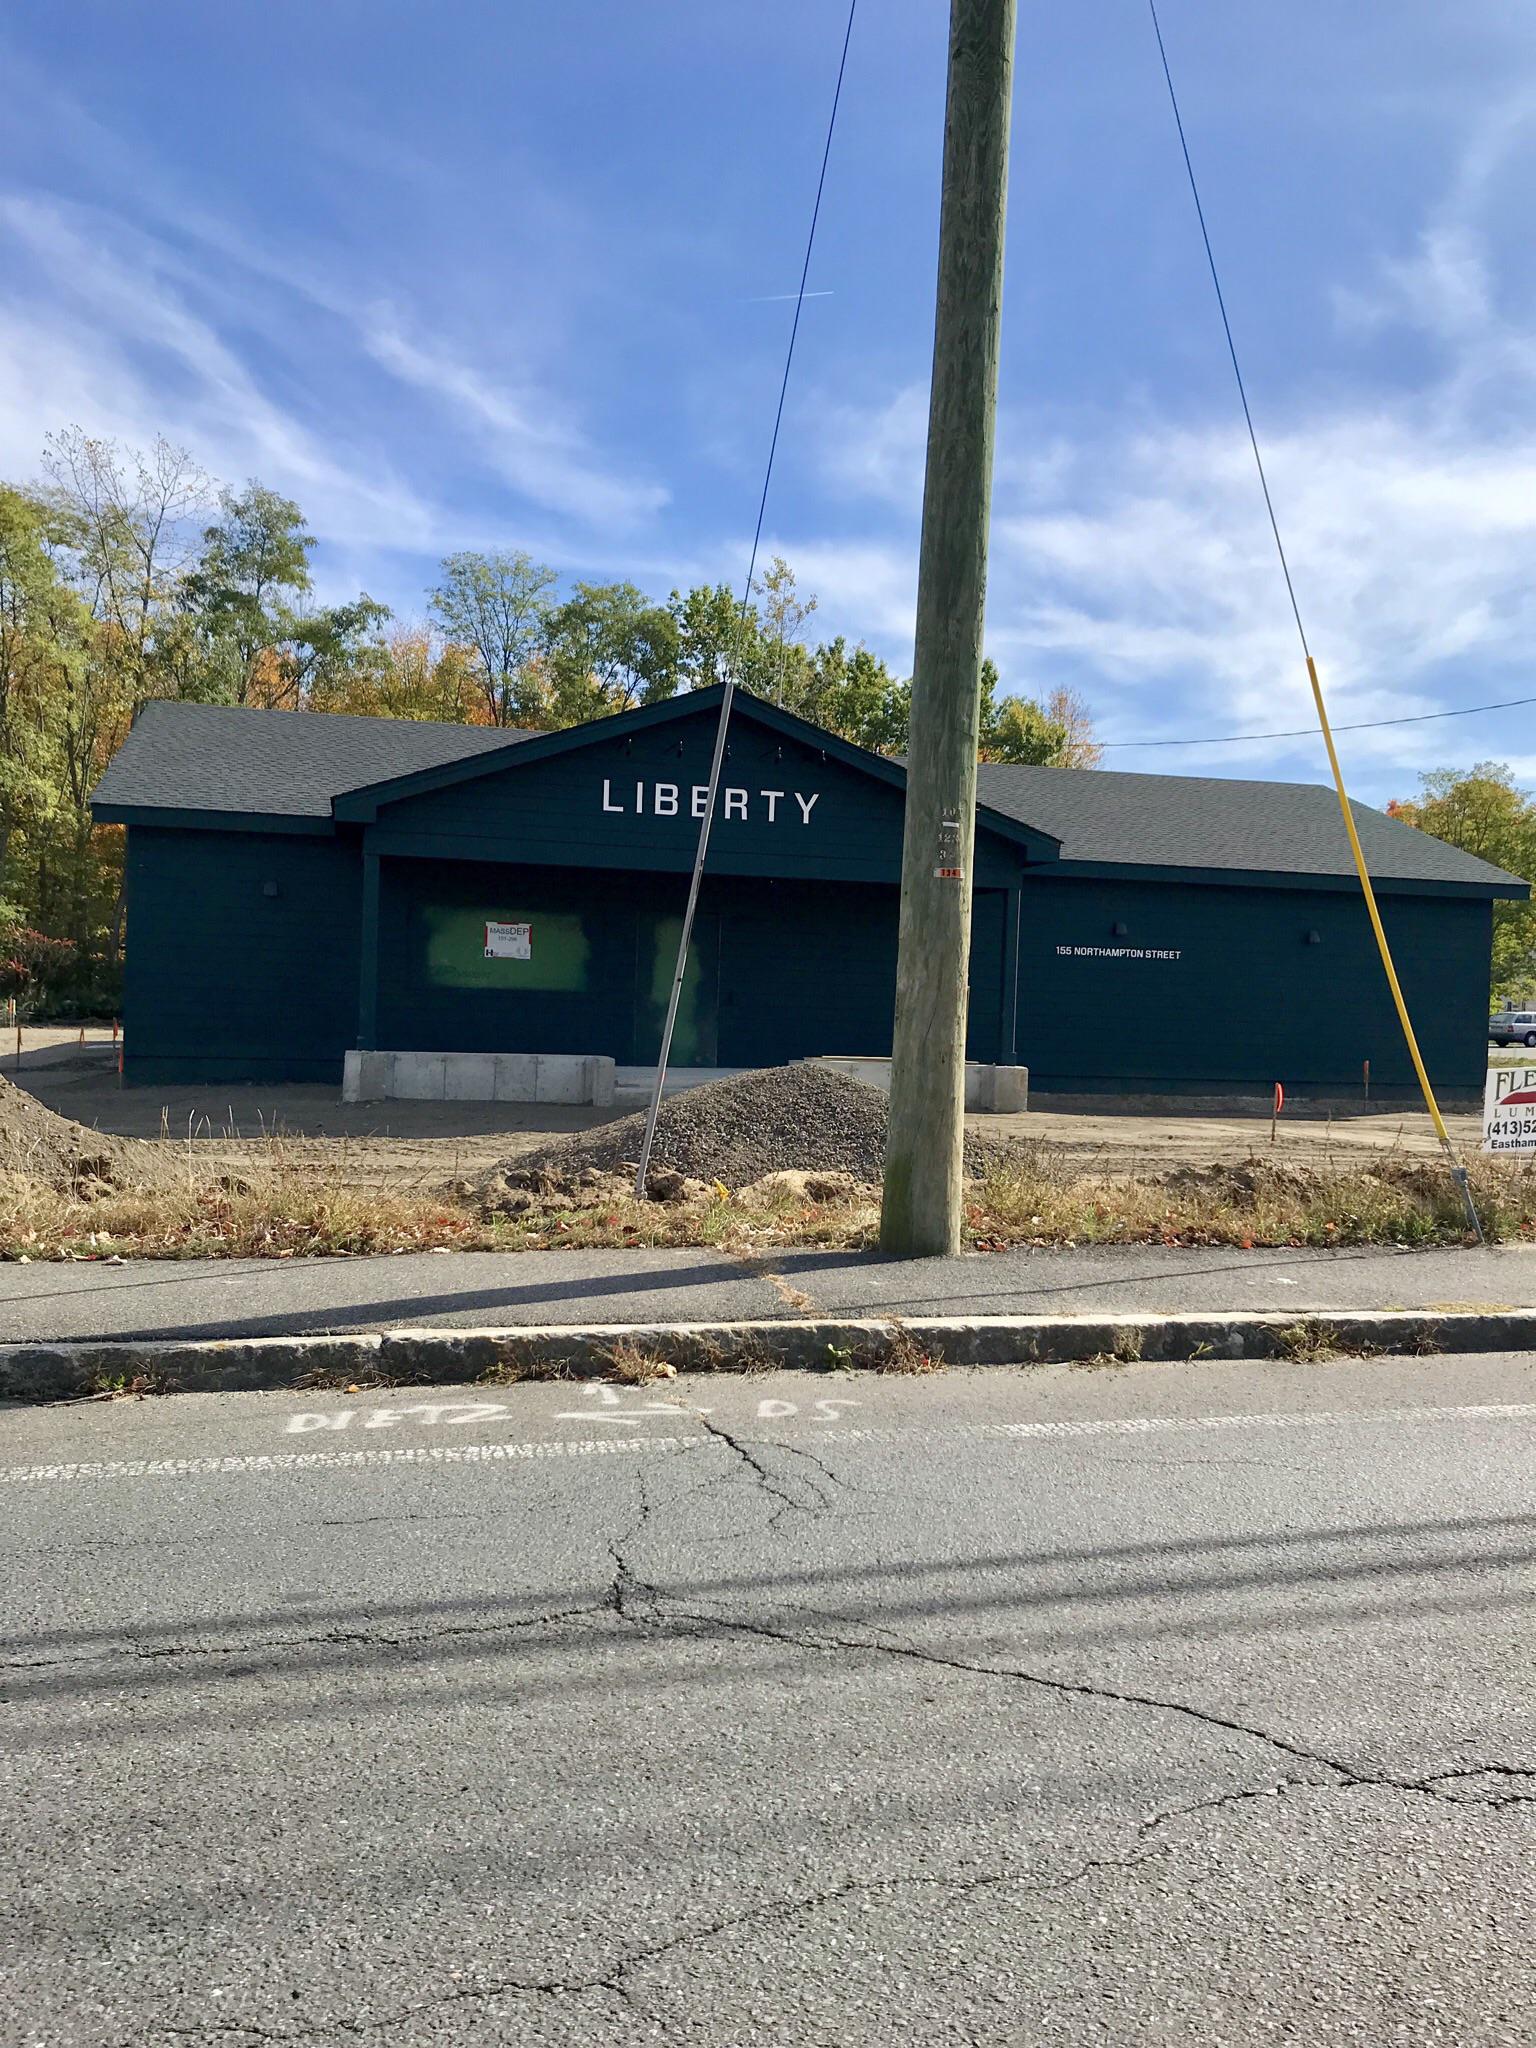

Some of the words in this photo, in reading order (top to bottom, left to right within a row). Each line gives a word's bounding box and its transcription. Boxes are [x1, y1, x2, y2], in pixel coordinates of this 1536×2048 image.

[602, 779, 820, 825] LIBERTY
[1056, 946, 1072, 955] 155
[1074, 946, 1144, 958] NORTHAMPTON
[1145, 949, 1181, 960] STREET
[1495, 1070, 1536, 1101] FLE
[1494, 1106, 1535, 1118] LUM
